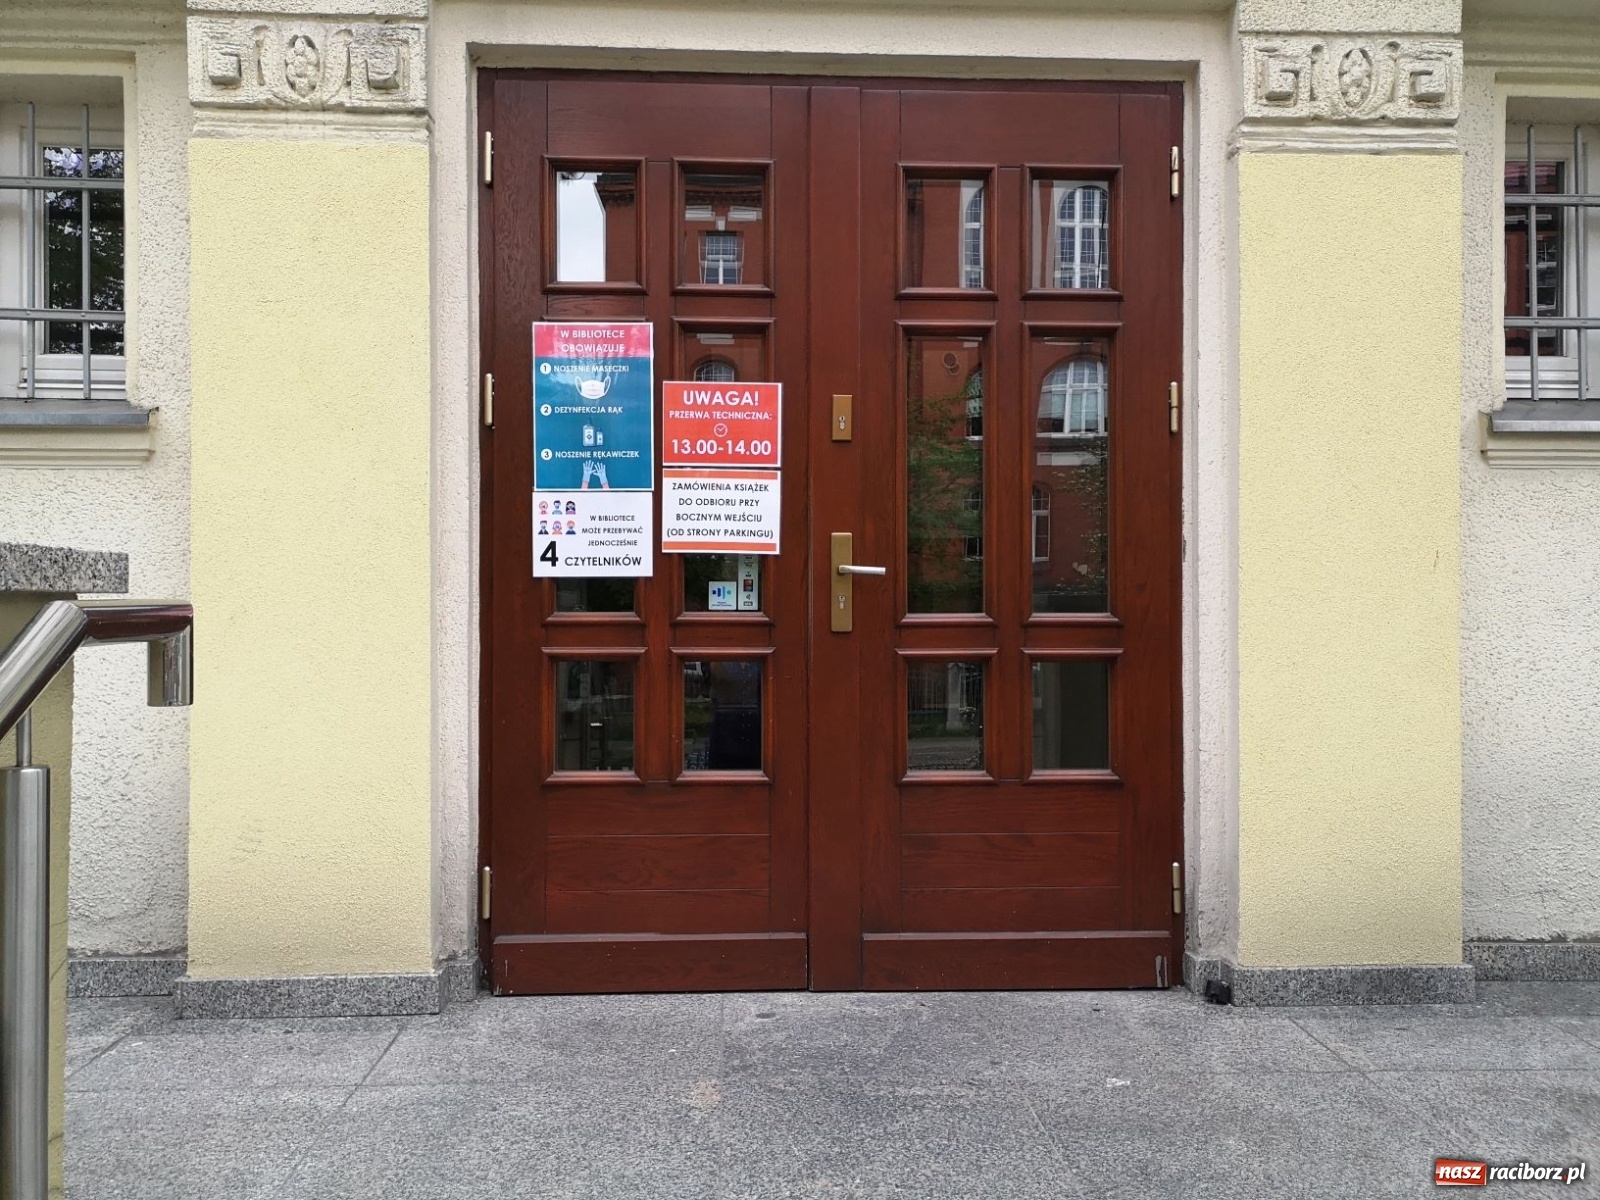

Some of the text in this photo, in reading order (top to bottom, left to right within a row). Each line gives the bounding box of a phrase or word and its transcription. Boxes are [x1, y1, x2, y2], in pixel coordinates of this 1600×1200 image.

[561, 330, 625, 338] W BIBLIOTECE
[561, 344, 625, 353] OBOWIĄZUJE
[683, 390, 759, 406] UWAGA!
[554, 406, 606, 414] DEZYNFEKCJA
[608, 406, 623, 415] RĄK
[669, 410, 773, 420] PRZERWA TECHNICZNA:
[671, 439, 772, 455] 13.00-14.00
[593, 451, 640, 459] RĘKAWICZEK
[672, 481, 769, 493] ZAMÓWIENIA KSIĄŻEK
[679, 498, 760, 507] DO ODBIORU PRZY
[676, 512, 762, 522] BOCZNYM WEJŚCIU
[582, 526, 643, 534] MOŻE PRZEBYWAĆ
[667, 528, 774, 539] (OD STRONY PARKINGU)
[540, 541, 642, 567] 4 CZYTELNIKÓW
